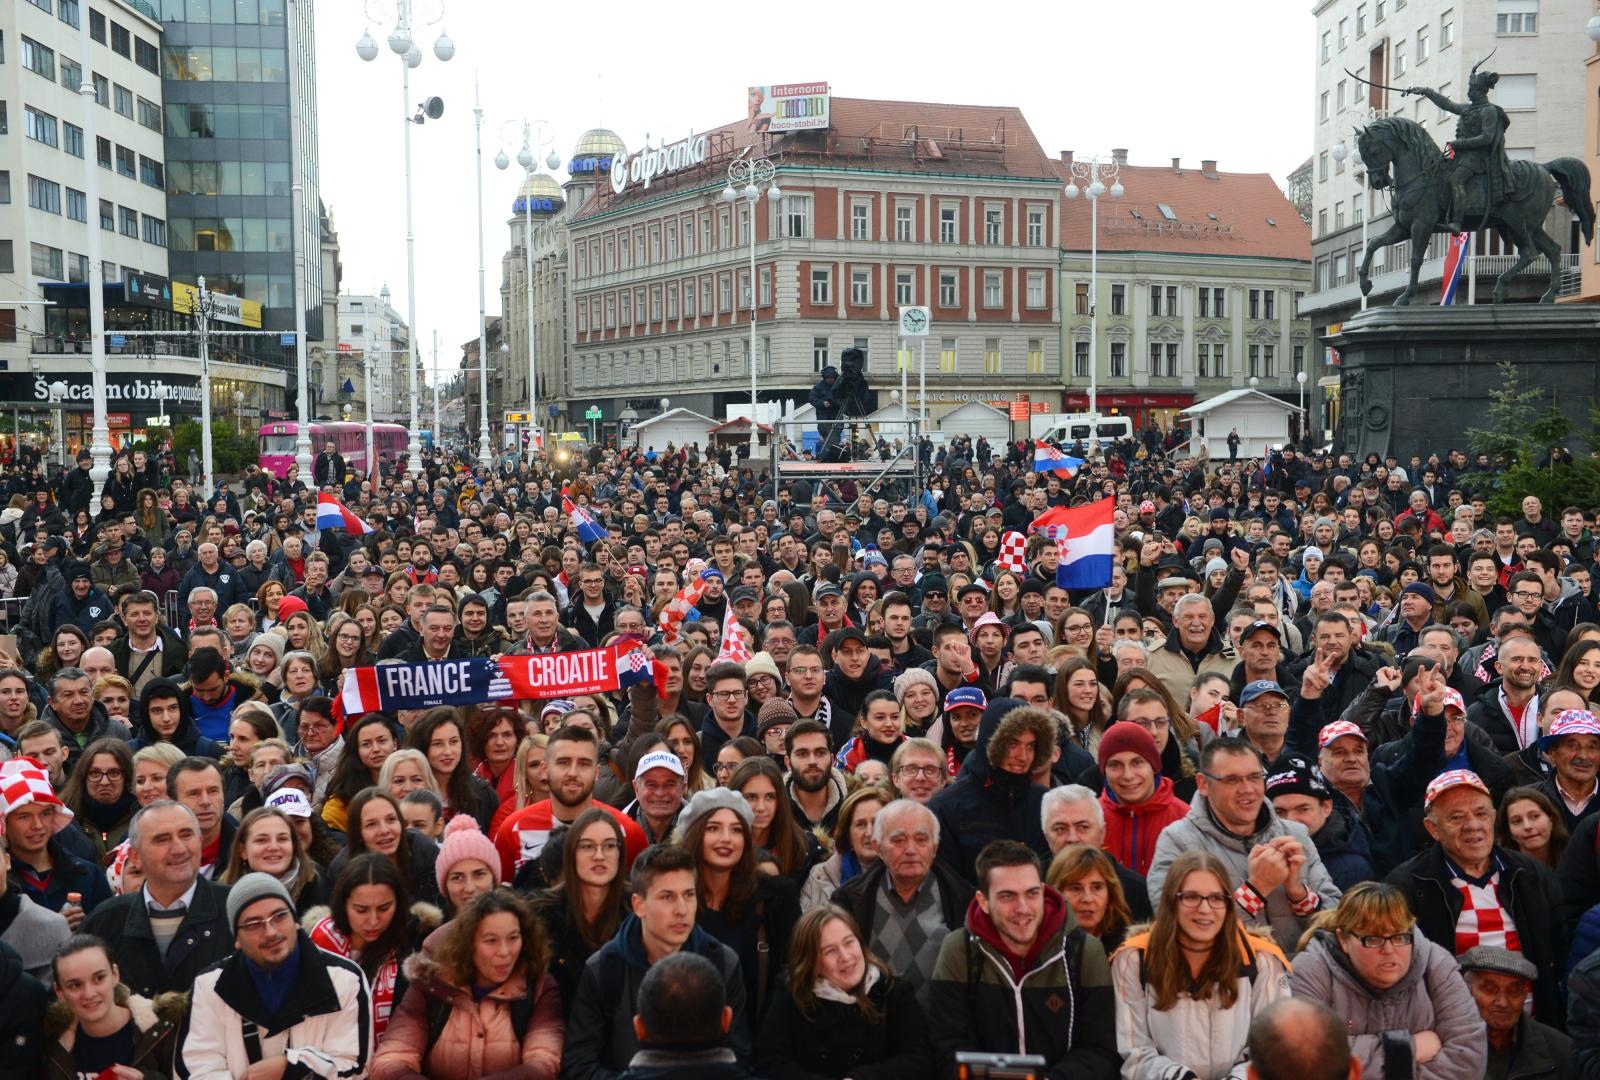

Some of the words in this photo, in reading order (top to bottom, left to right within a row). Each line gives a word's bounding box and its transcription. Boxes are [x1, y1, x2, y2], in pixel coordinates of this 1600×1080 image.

[773, 85, 826, 96] Internorm
[771, 119, 826, 129] hoco-stabil.hr
[227, 303, 240, 318] BANK
[527, 650, 609, 687] CROATIE
[385, 661, 472, 697] FRANCE
[557, 686, 587, 695] NOVEMBRE
[643, 754, 676, 765] CROATIA
